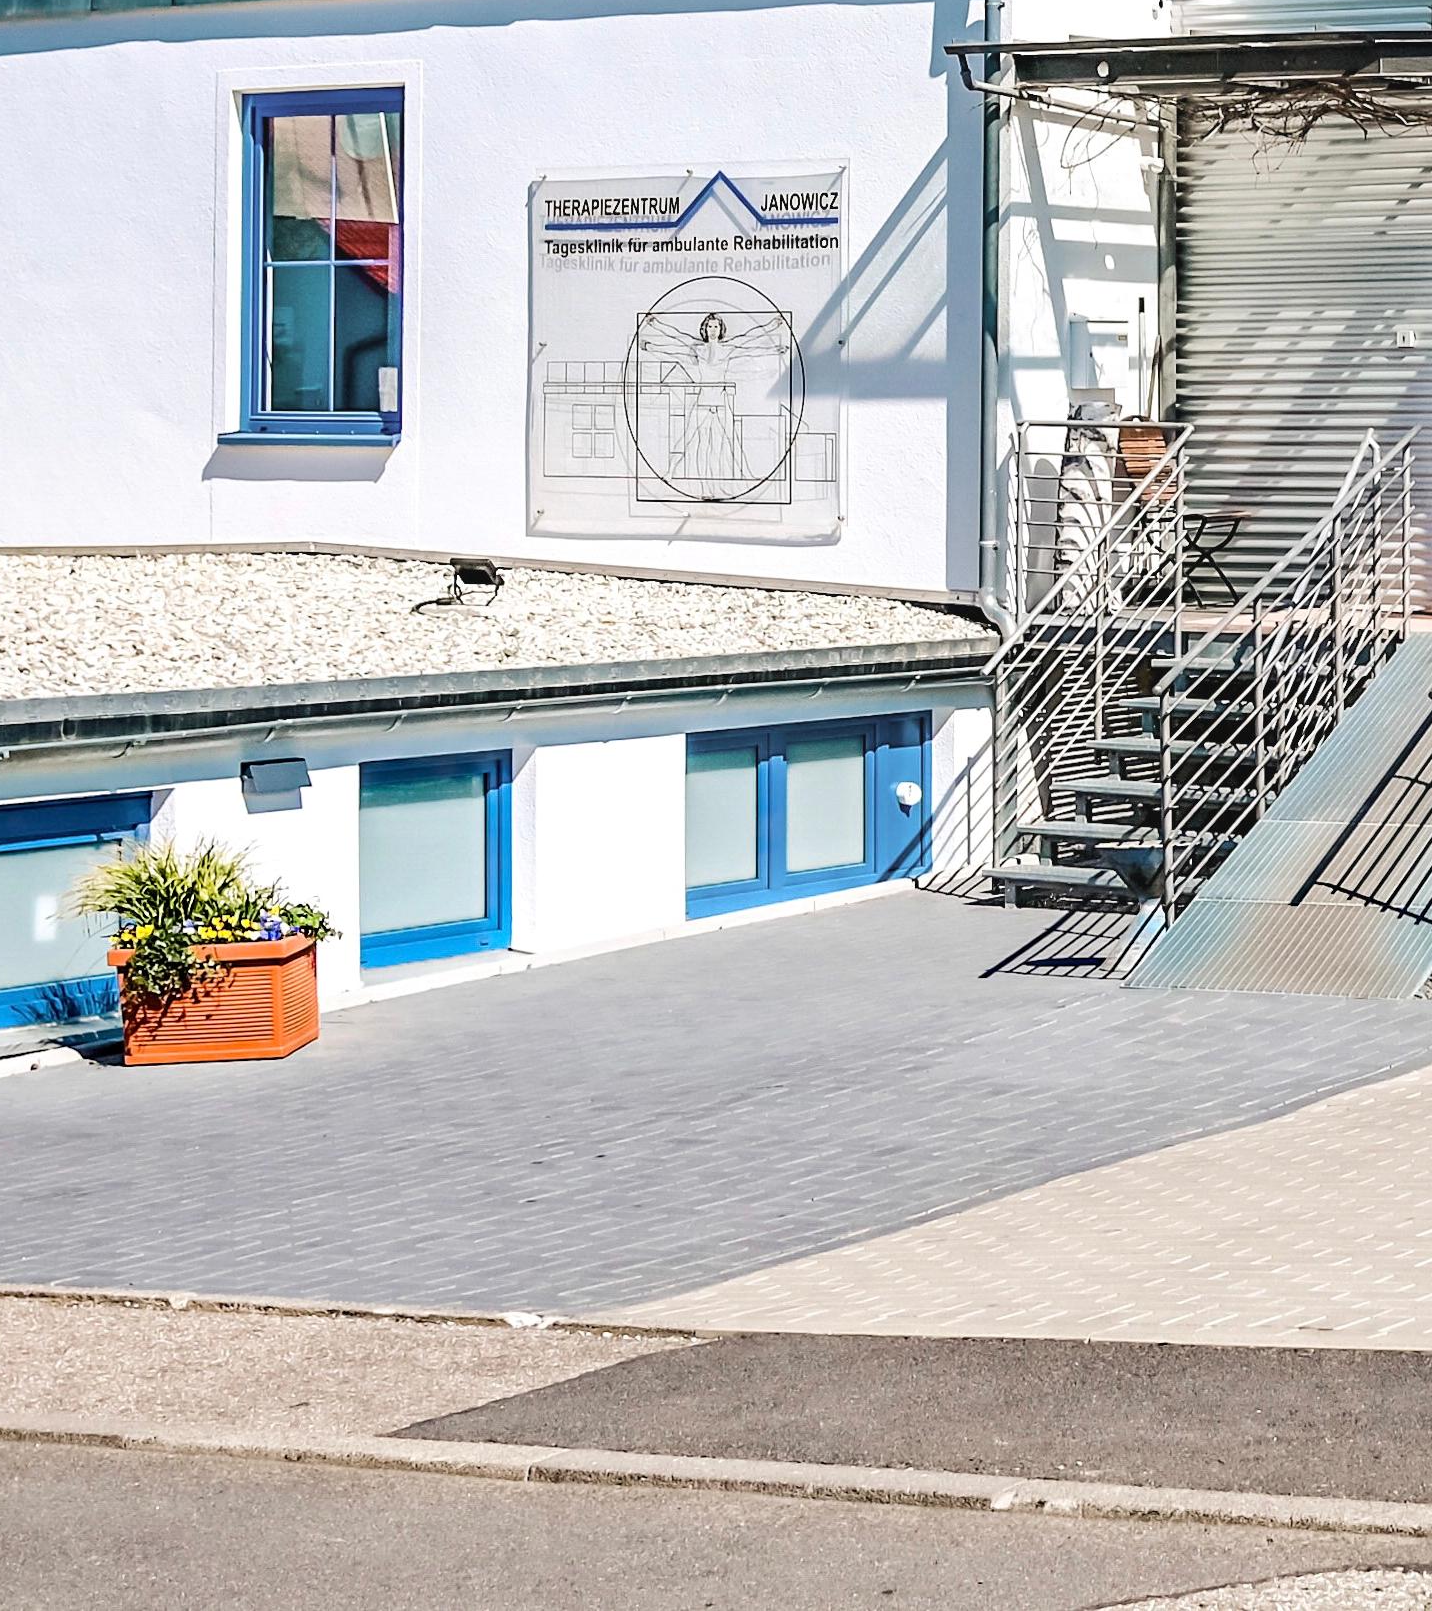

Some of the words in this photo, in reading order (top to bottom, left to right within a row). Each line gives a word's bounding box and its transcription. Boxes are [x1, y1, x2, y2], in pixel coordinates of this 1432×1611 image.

[545, 197, 680, 217] THERAPIEZENTRUM
[761, 192, 839, 211] JANOWICZ
[544, 238, 624, 258] Tagesklinik
[628, 237, 648, 253] für
[652, 236, 729, 252] ambulante
[733, 234, 839, 251] Rehabilitation
